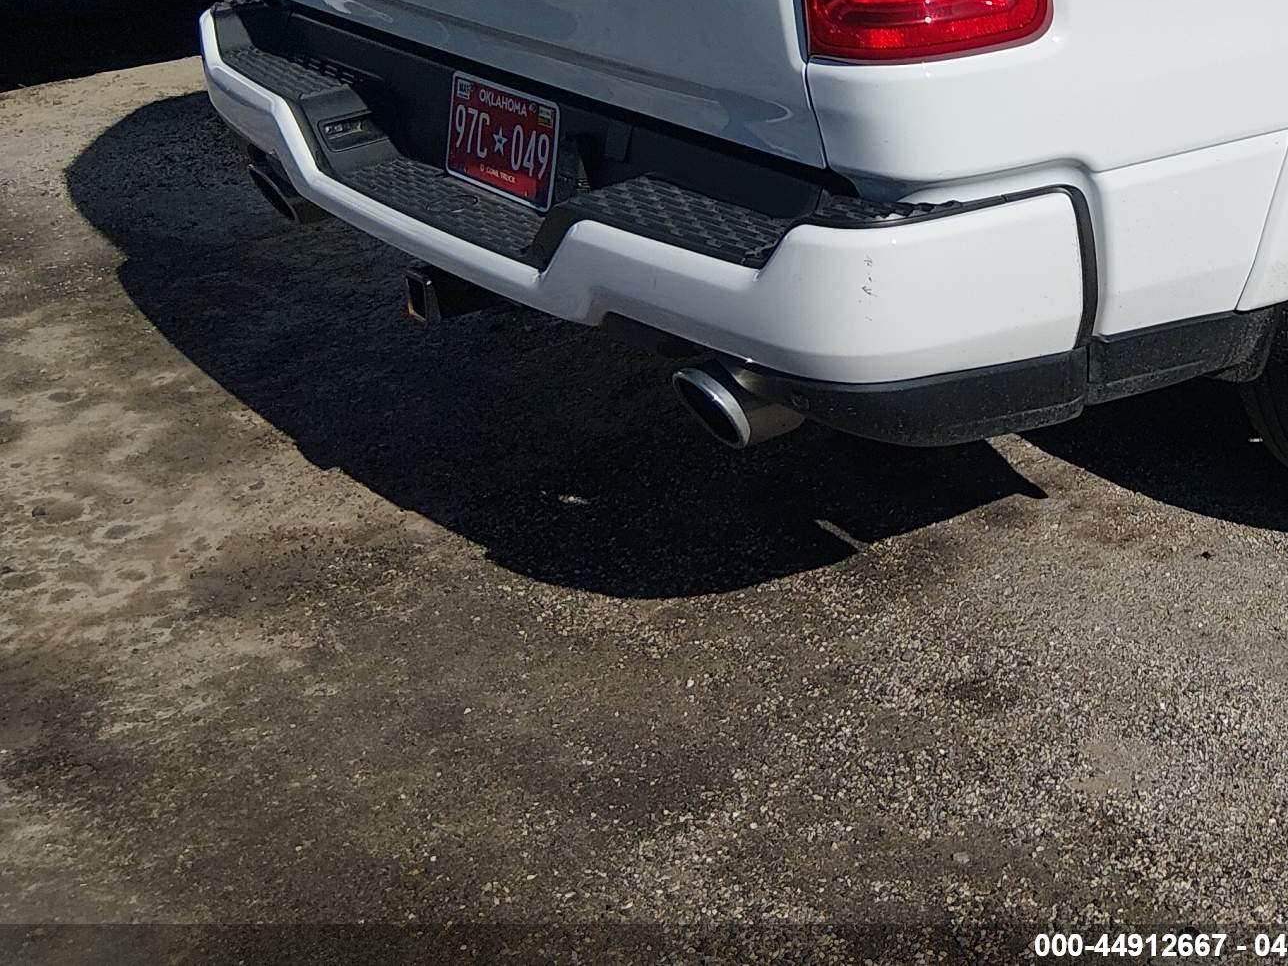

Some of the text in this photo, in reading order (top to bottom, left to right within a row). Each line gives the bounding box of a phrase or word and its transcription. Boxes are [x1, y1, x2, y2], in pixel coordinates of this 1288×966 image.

[478, 89, 528, 117] OKLAHOMA
[455, 104, 491, 159] 97C
[510, 124, 551, 180] 049
